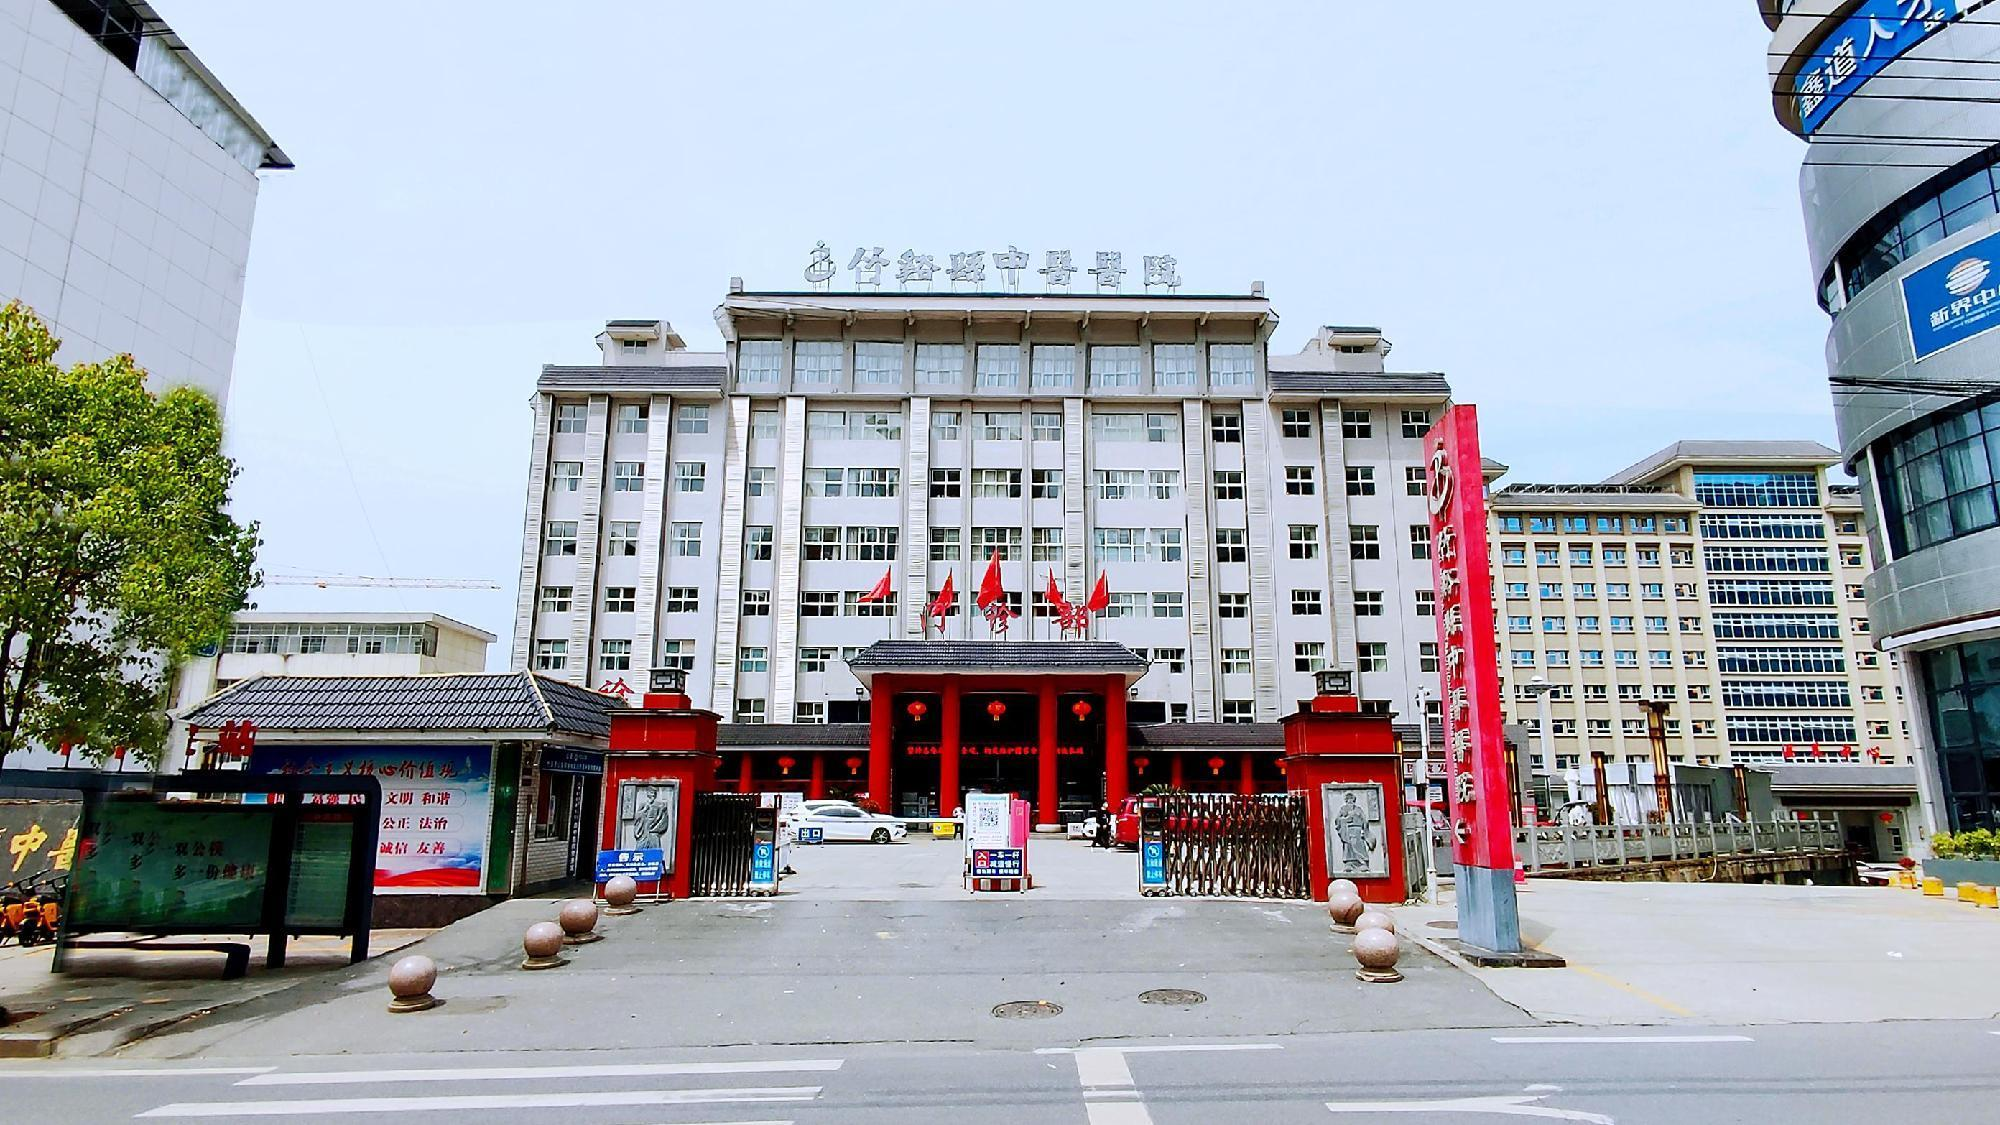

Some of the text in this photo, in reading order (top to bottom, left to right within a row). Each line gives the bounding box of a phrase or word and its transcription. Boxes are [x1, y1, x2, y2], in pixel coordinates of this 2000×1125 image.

[1930, 286, 2000, 328] 新界中
[386, 792, 413, 805] 文明
[421, 792, 451, 805] 和谐
[383, 817, 449, 830] 公正 法治
[801, 829, 821, 838] 出口
[416, 842, 446, 855] 友善
